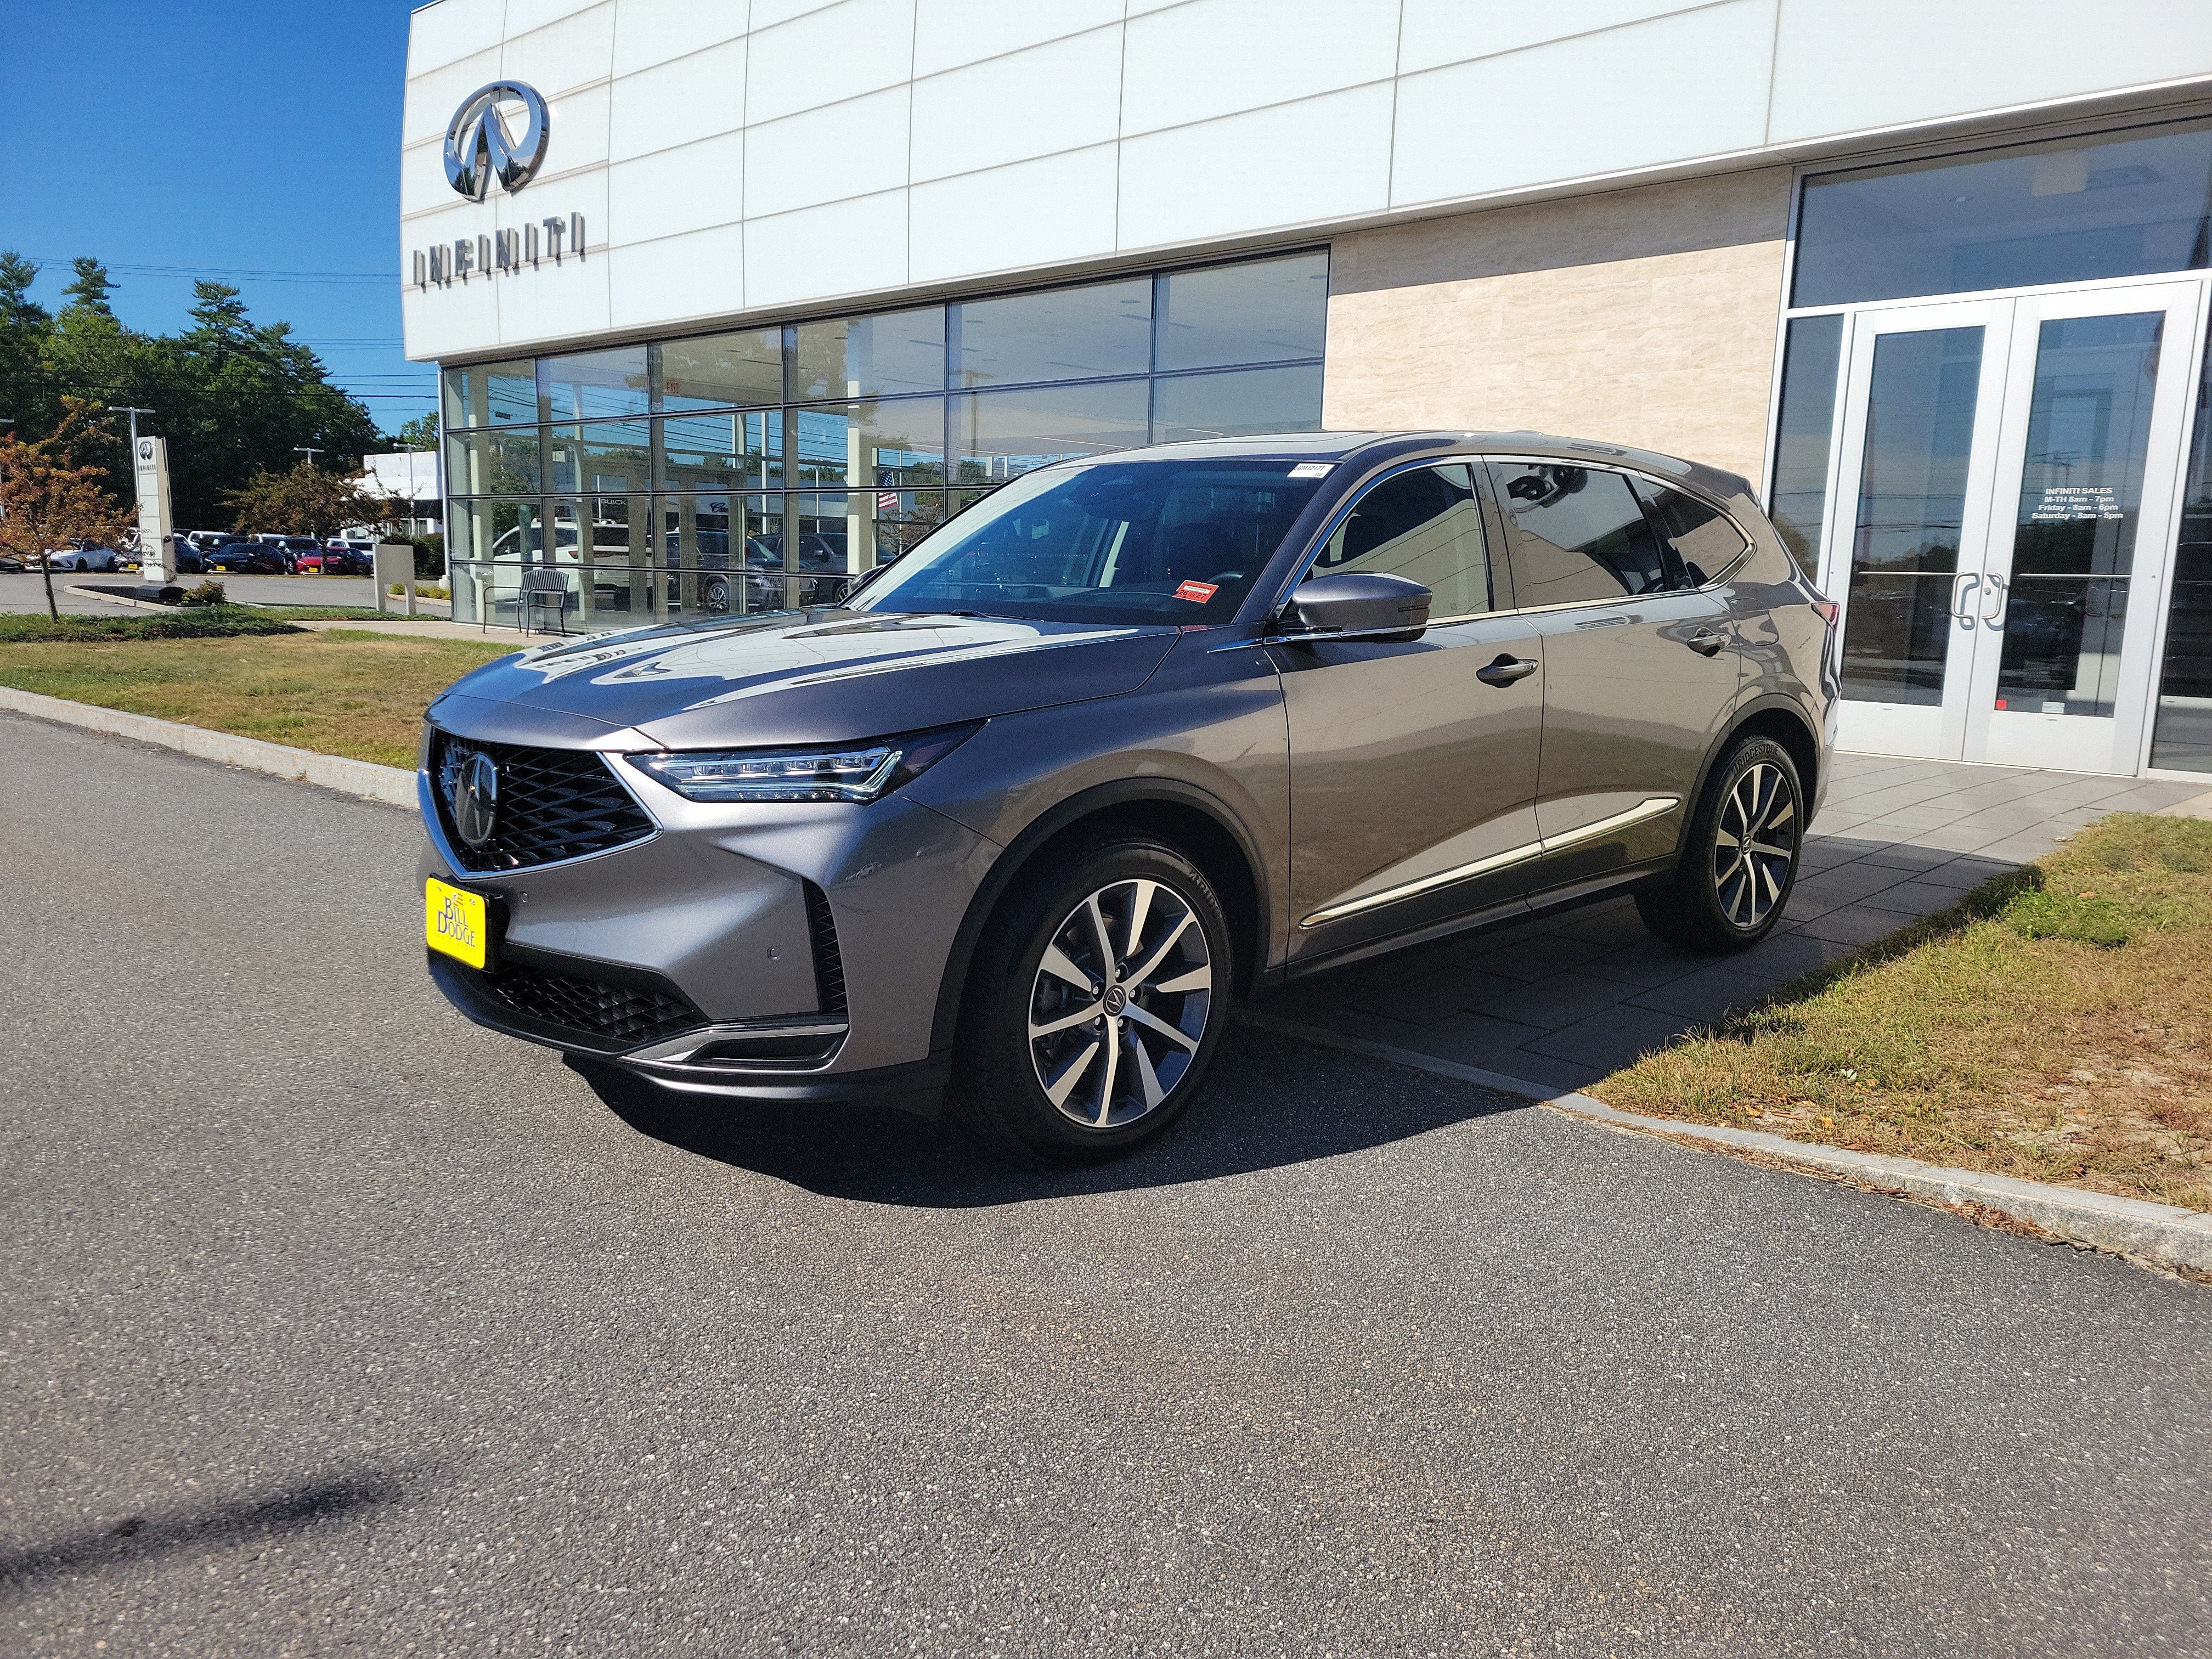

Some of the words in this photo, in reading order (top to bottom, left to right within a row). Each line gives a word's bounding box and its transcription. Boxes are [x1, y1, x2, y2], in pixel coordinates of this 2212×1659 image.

[413, 212, 583, 285] INFINITI
[1731, 744, 1779, 776] BRIDGESTONE
[437, 910, 476, 947] DODGE
[444, 896, 469, 927] BILL
